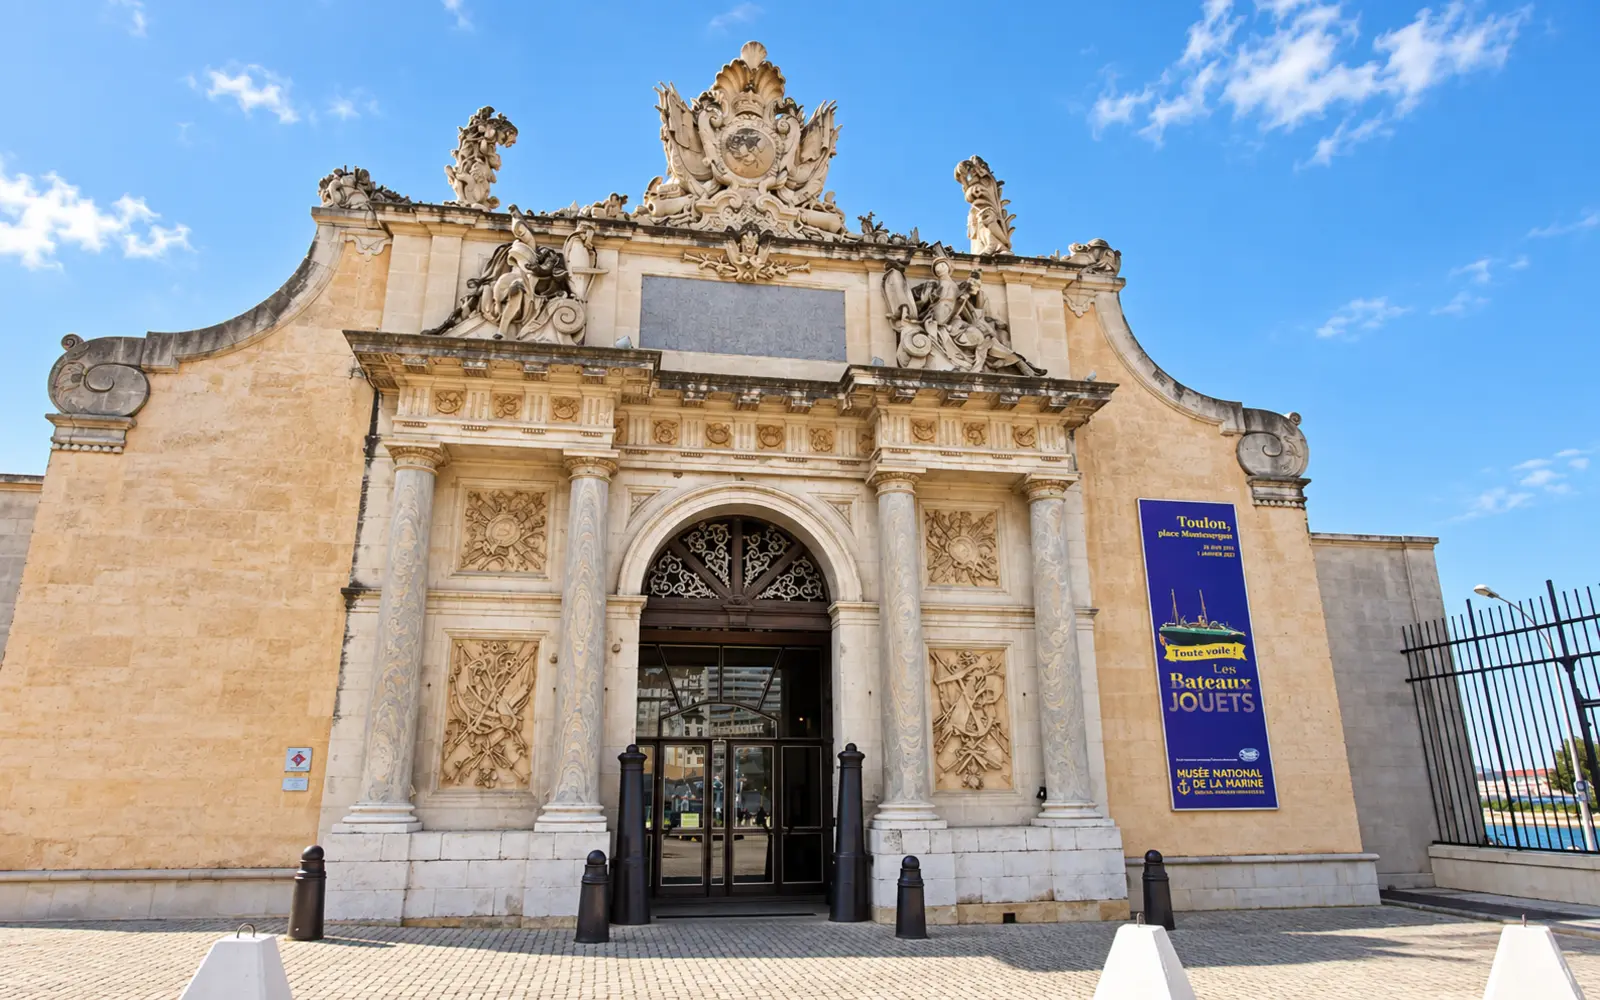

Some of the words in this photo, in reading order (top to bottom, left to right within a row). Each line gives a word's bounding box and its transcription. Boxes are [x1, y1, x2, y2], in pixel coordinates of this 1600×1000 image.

[1176, 515, 1231, 532] Toulon,
[1158, 529, 1179, 538] place
[1172, 649, 1204, 657] Toute
[1206, 646, 1230, 655] voile
[1213, 663, 1237, 674] Les
[1169, 672, 1252, 690] Bateaux
[1168, 692, 1255, 713] JOUETS
[1177, 767, 1209, 778] MUSÉE
[1213, 769, 1263, 778] NATIONAL
[1193, 779, 1206, 788] DE
[1210, 779, 1223, 788] LA
[1226, 779, 1264, 788] MARINE
